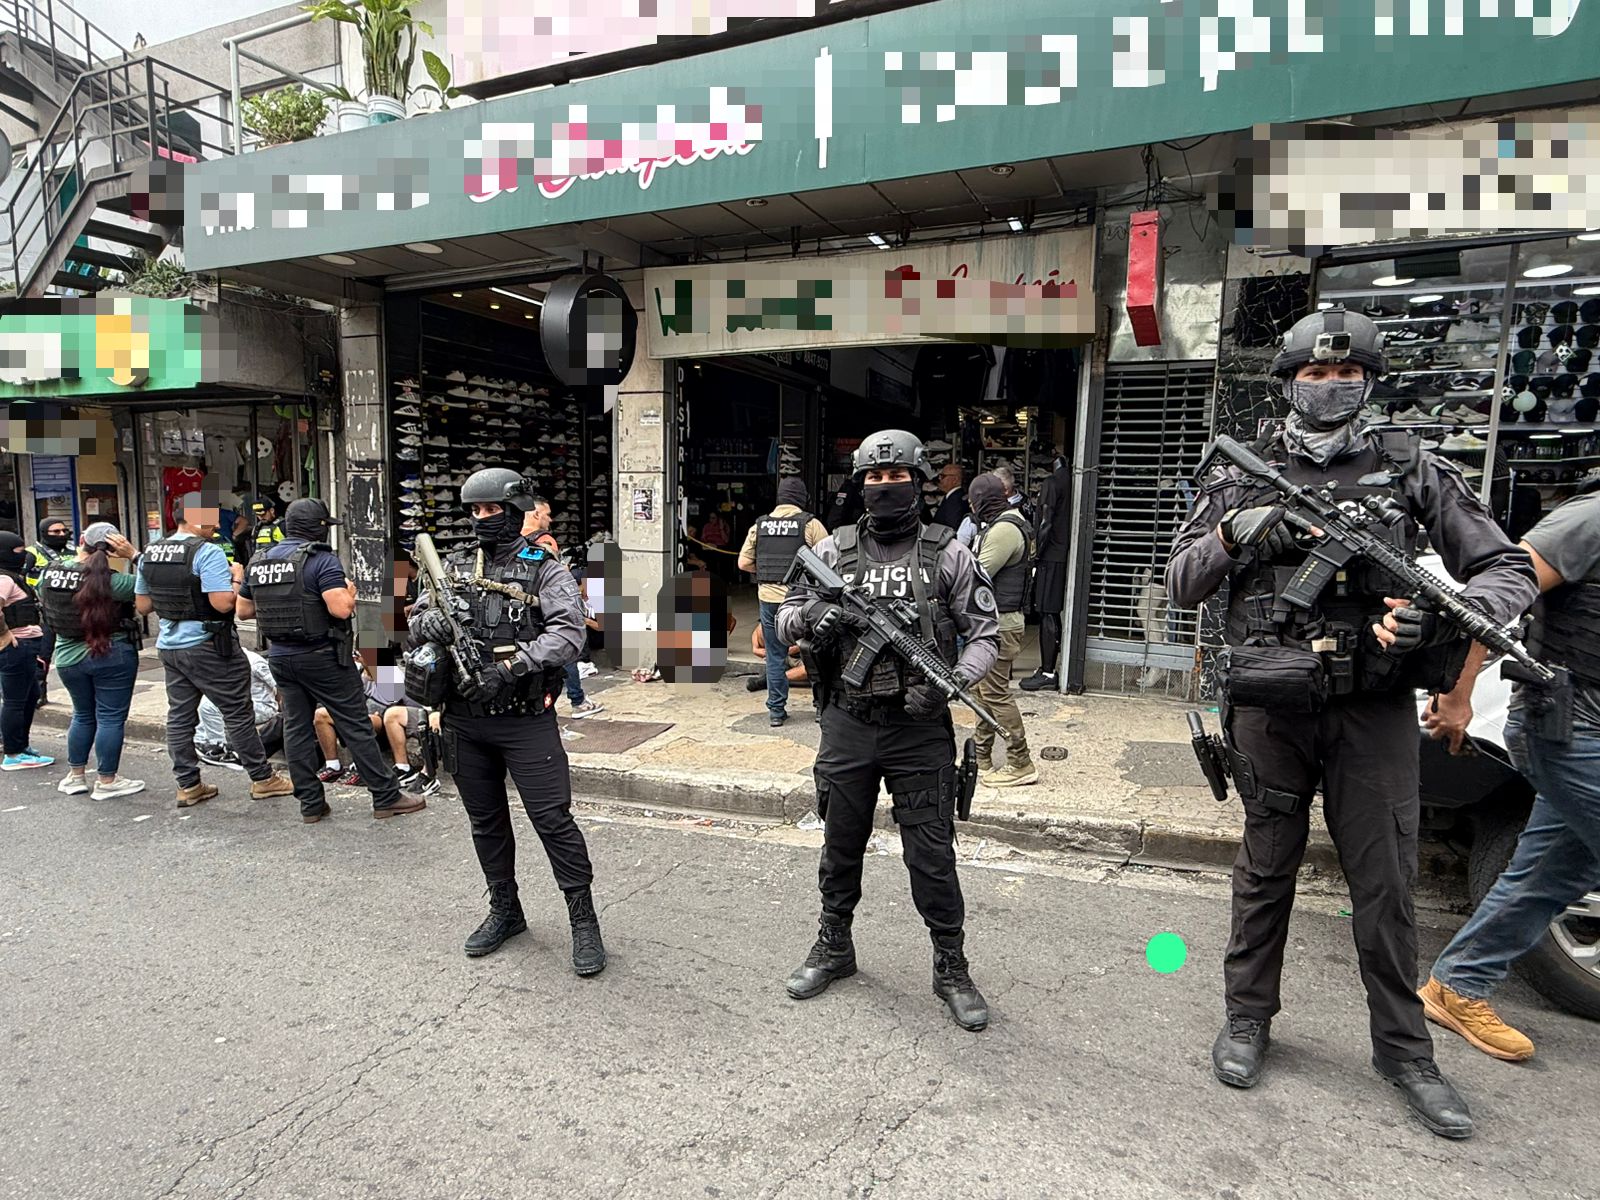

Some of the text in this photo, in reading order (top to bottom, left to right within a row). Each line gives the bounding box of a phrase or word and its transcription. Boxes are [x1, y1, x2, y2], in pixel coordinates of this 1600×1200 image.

[761, 520, 799, 529] POLICIA
[767, 528, 788, 536] OIJ
[144, 544, 185, 554] POLICIA
[151, 552, 172, 561] OIJ
[250, 562, 294, 576] POLICIA
[44, 570, 86, 582] POLICI
[258, 573, 282, 584] OIJ
[50, 578, 78, 589] OIJ
